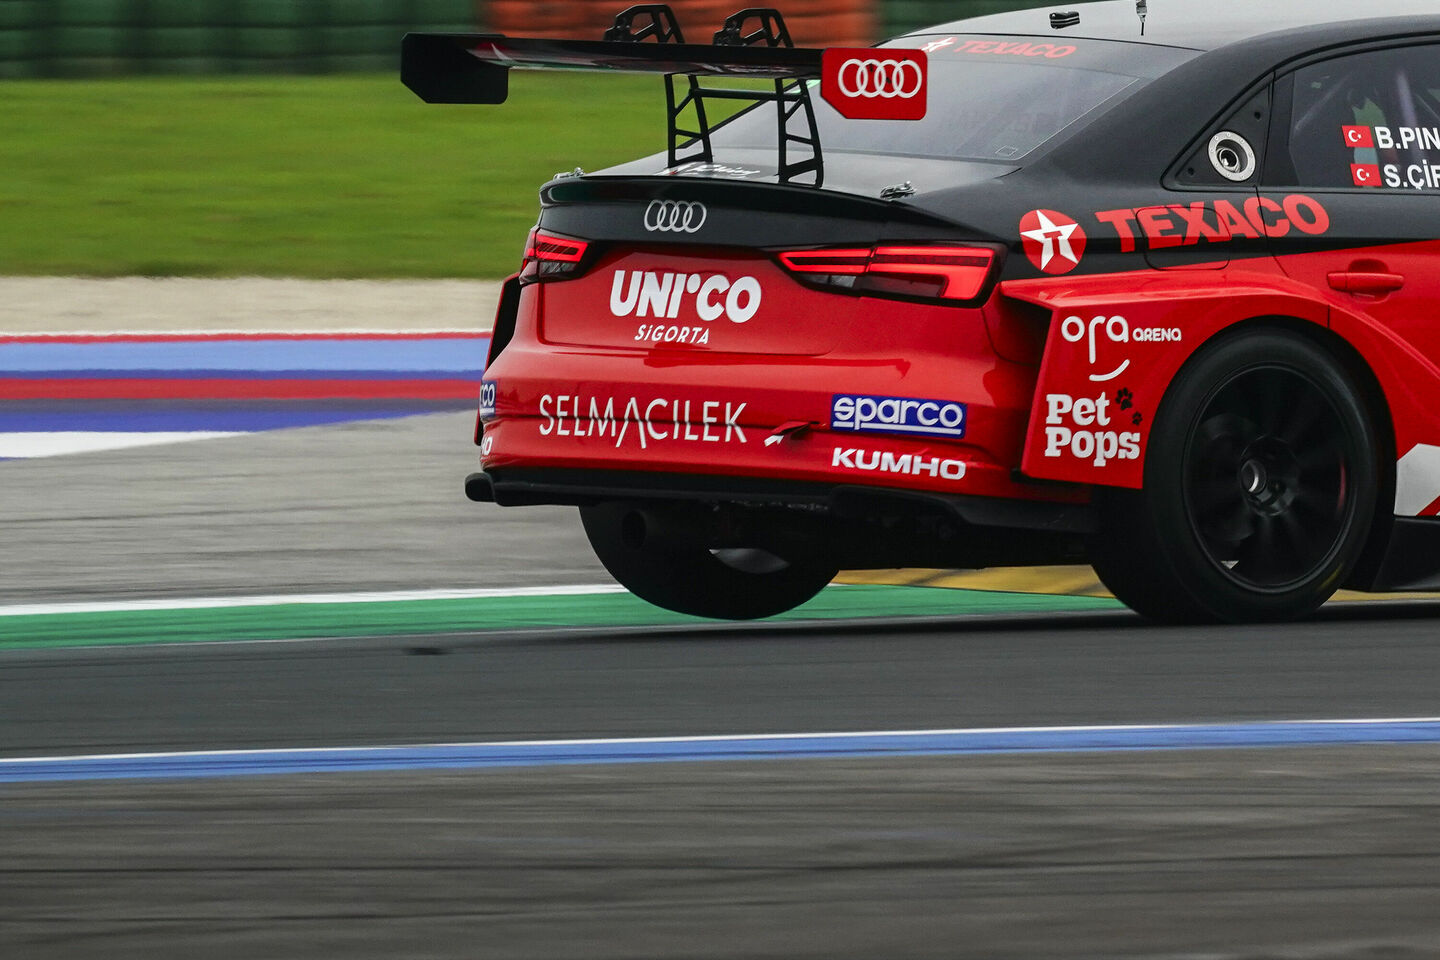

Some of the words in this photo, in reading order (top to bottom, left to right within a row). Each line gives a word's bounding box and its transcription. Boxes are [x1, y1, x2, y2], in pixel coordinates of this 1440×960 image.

[953, 40, 1077, 59] TEXACO
[1095, 195, 1330, 253] TEXACO
[538, 394, 748, 449] SELMACILEK
[833, 396, 963, 431] sparco
[1045, 391, 1111, 426] Pet
[831, 447, 967, 480] KUMHO
[1044, 426, 1141, 467] Pops
